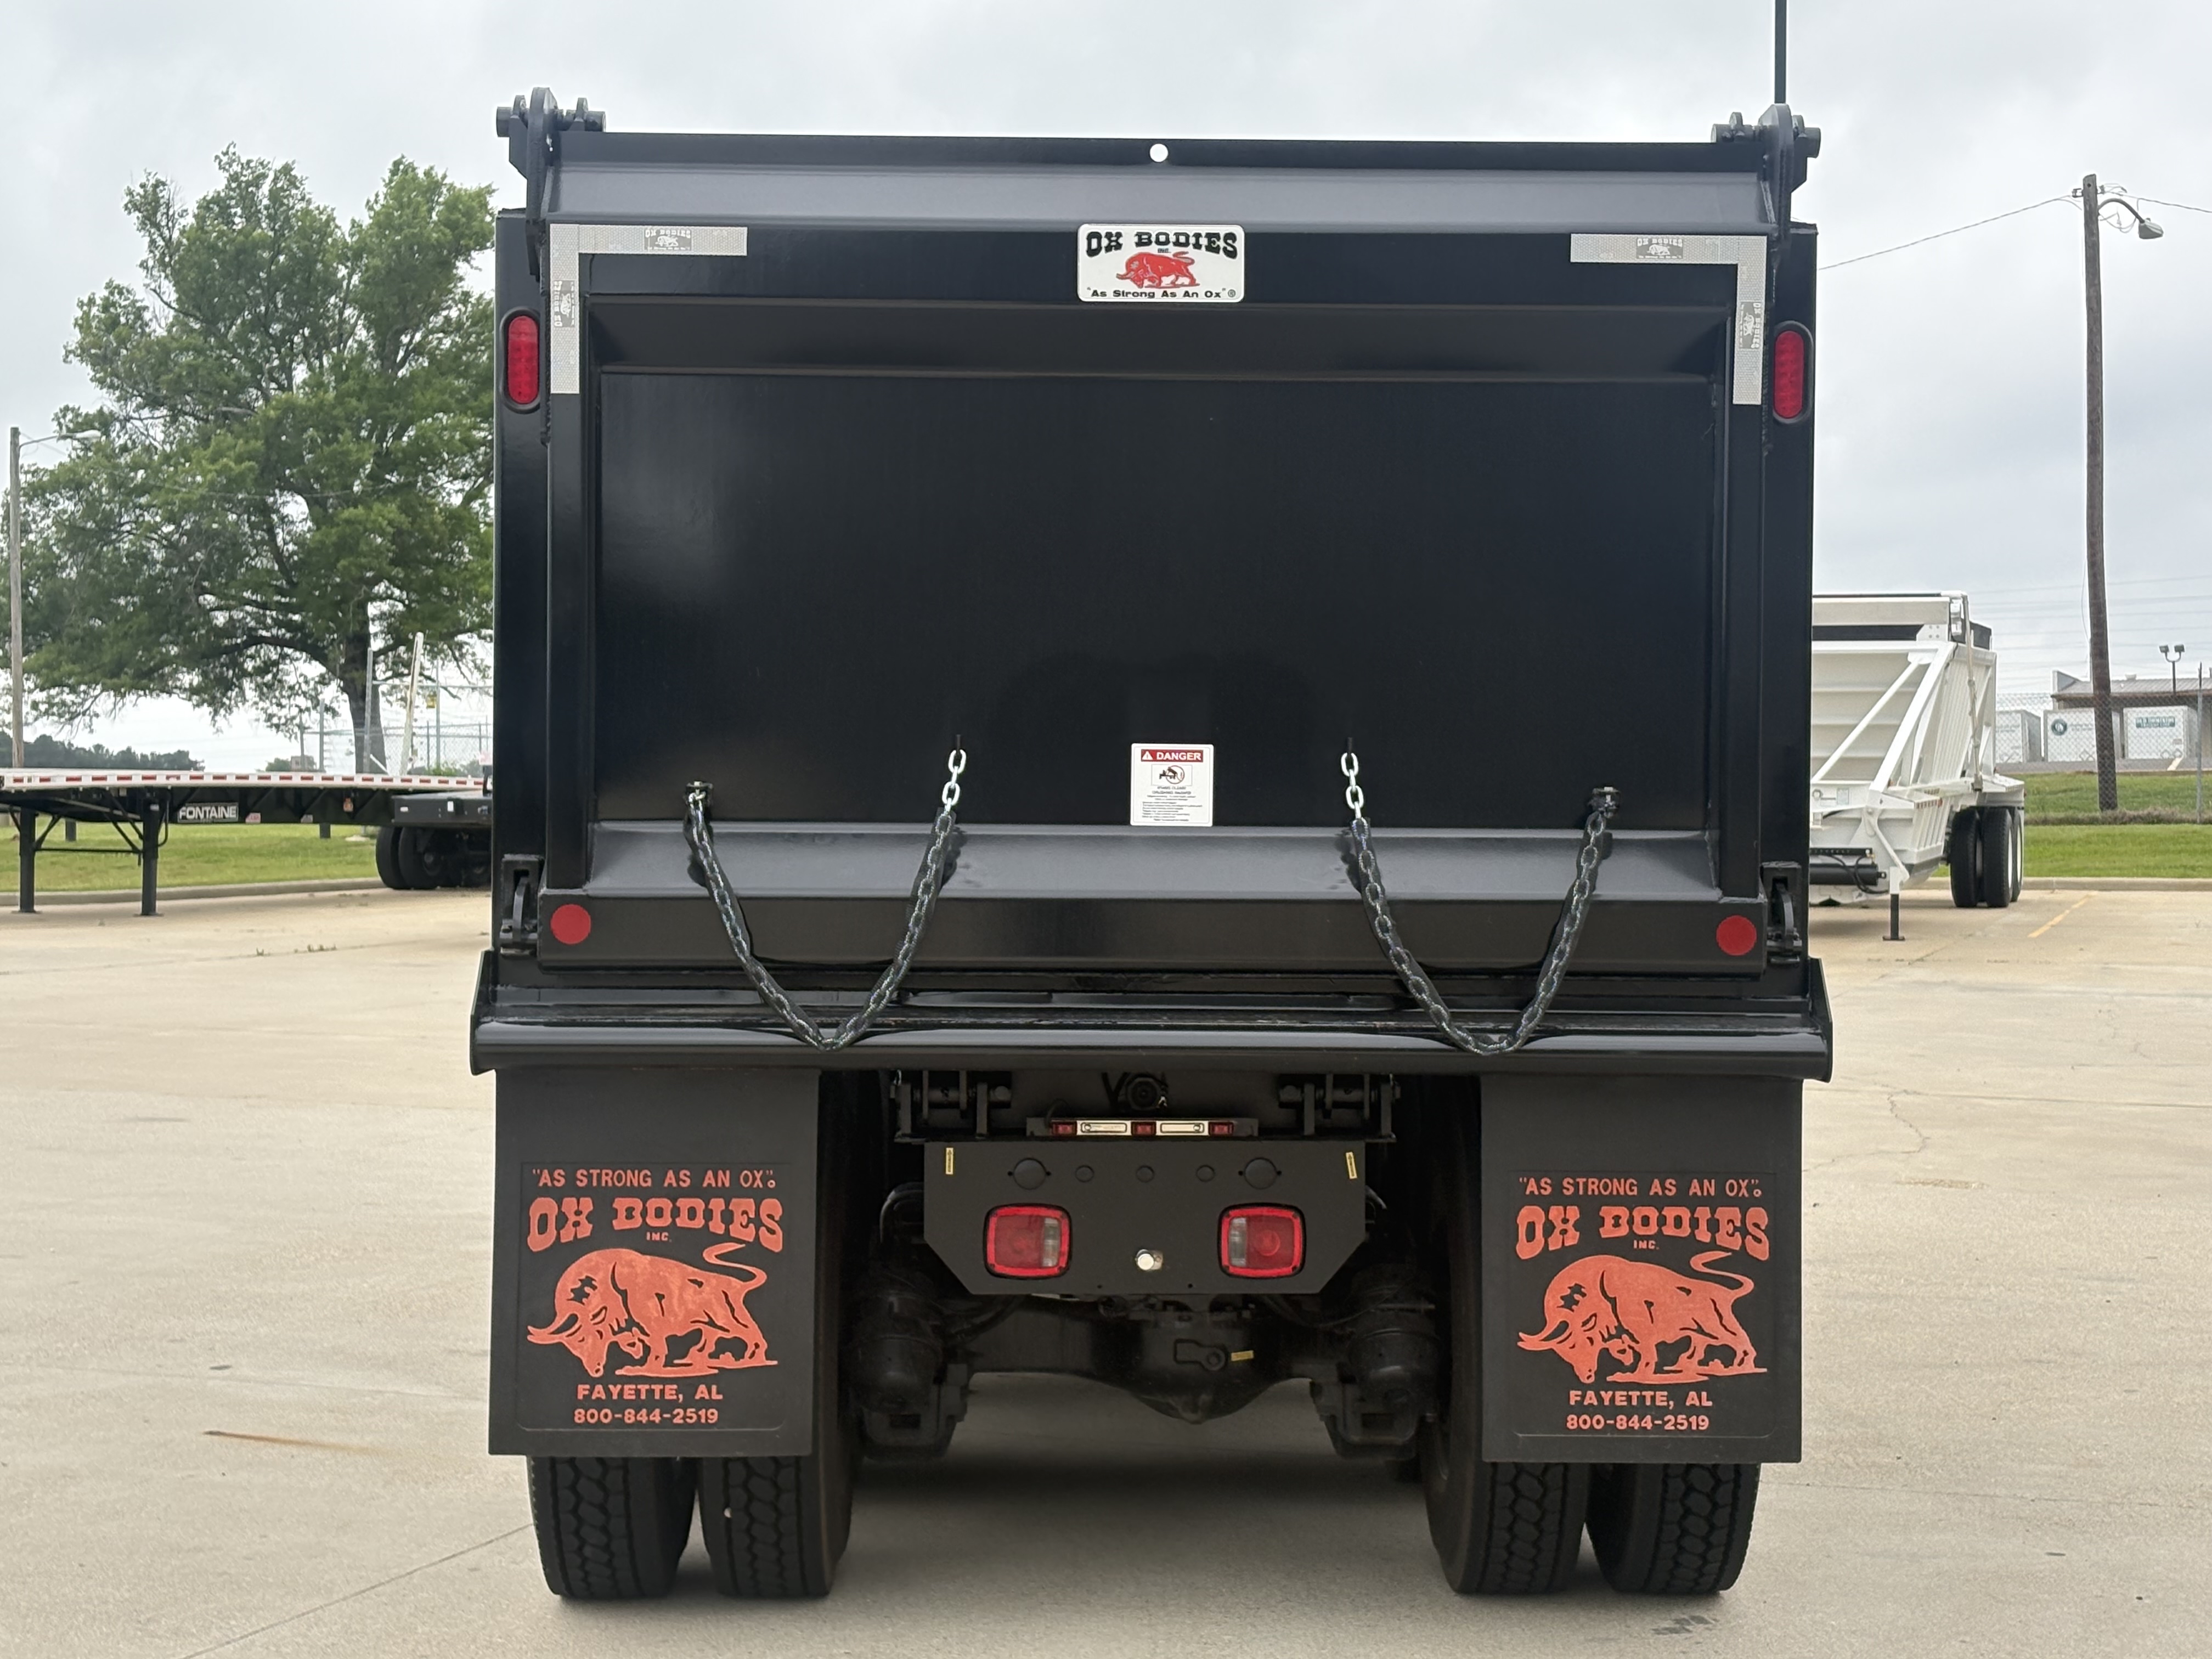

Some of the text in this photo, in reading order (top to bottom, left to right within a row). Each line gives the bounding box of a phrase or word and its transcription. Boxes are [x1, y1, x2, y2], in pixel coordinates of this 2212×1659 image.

[1086, 231, 1238, 259] OX BODIES
[1113, 290, 1155, 299] Strong
[1156, 752, 1201, 761] DANGER
[179, 805, 237, 820] FONTAINE
[575, 1169, 652, 1188] STRONG
[664, 1170, 691, 1188] AS
[702, 1170, 731, 1188] AN
[1562, 1177, 1638, 1196] STRONG
[1650, 1178, 1677, 1196] AS
[1689, 1179, 1716, 1196] AN
[527, 1197, 783, 1252] OX BODIES
[1515, 1205, 1770, 1261] OX BODIES
[646, 1232, 672, 1242] INC.
[1633, 1239, 1660, 1250] INC.
[577, 1384, 724, 1402] FAYETTE, AL
[1569, 1390, 1713, 1409] FAYETTE, AL
[574, 1408, 719, 1424] 800-844-2519
[1566, 1414, 1709, 1430] 800-844-2519
